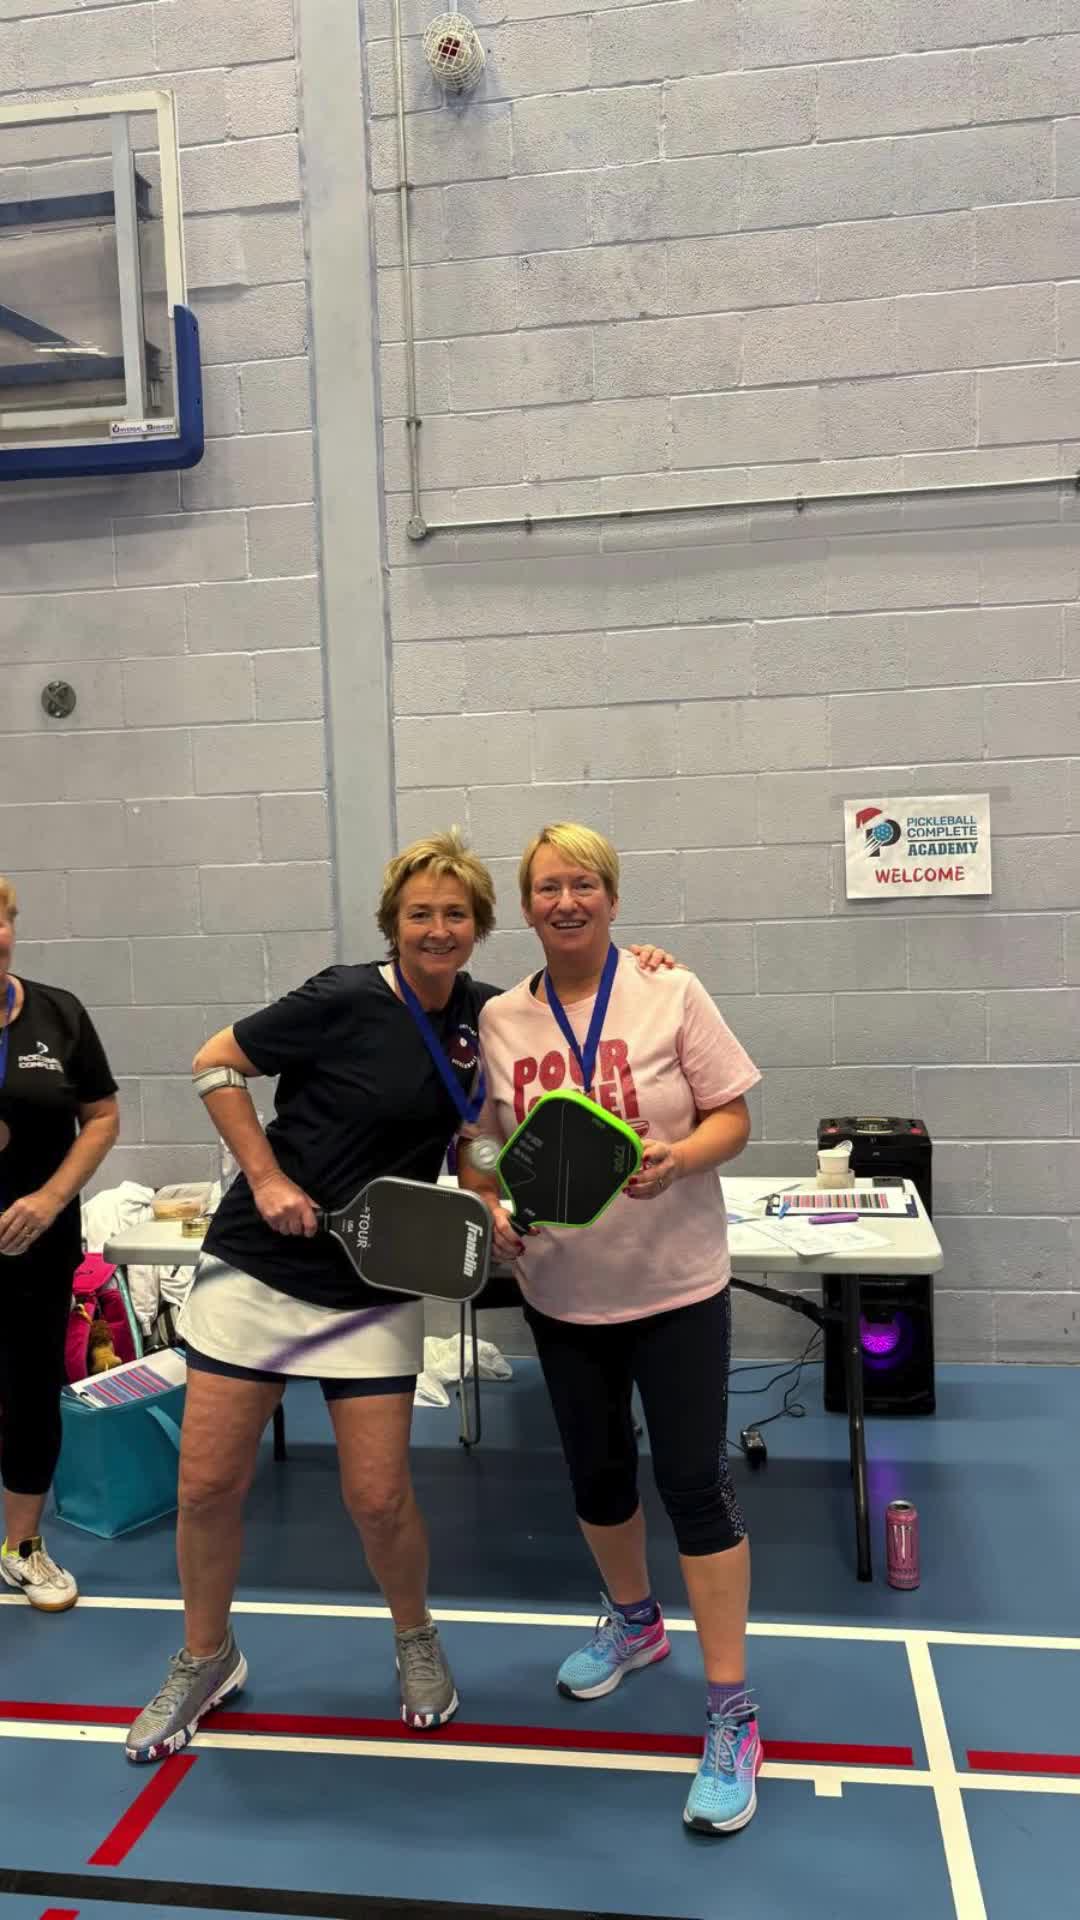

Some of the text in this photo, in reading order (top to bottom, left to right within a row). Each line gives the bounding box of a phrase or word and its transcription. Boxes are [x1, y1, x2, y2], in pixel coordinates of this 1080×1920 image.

[907, 816, 976, 827] PICKLEBALL
[906, 826, 978, 838] COMPLETE
[907, 842, 978, 856] ACADEMY
[875, 866, 966, 884] WELCOME
[356, 1213, 371, 1249] TOUR
[463, 1220, 484, 1278] Franklin
